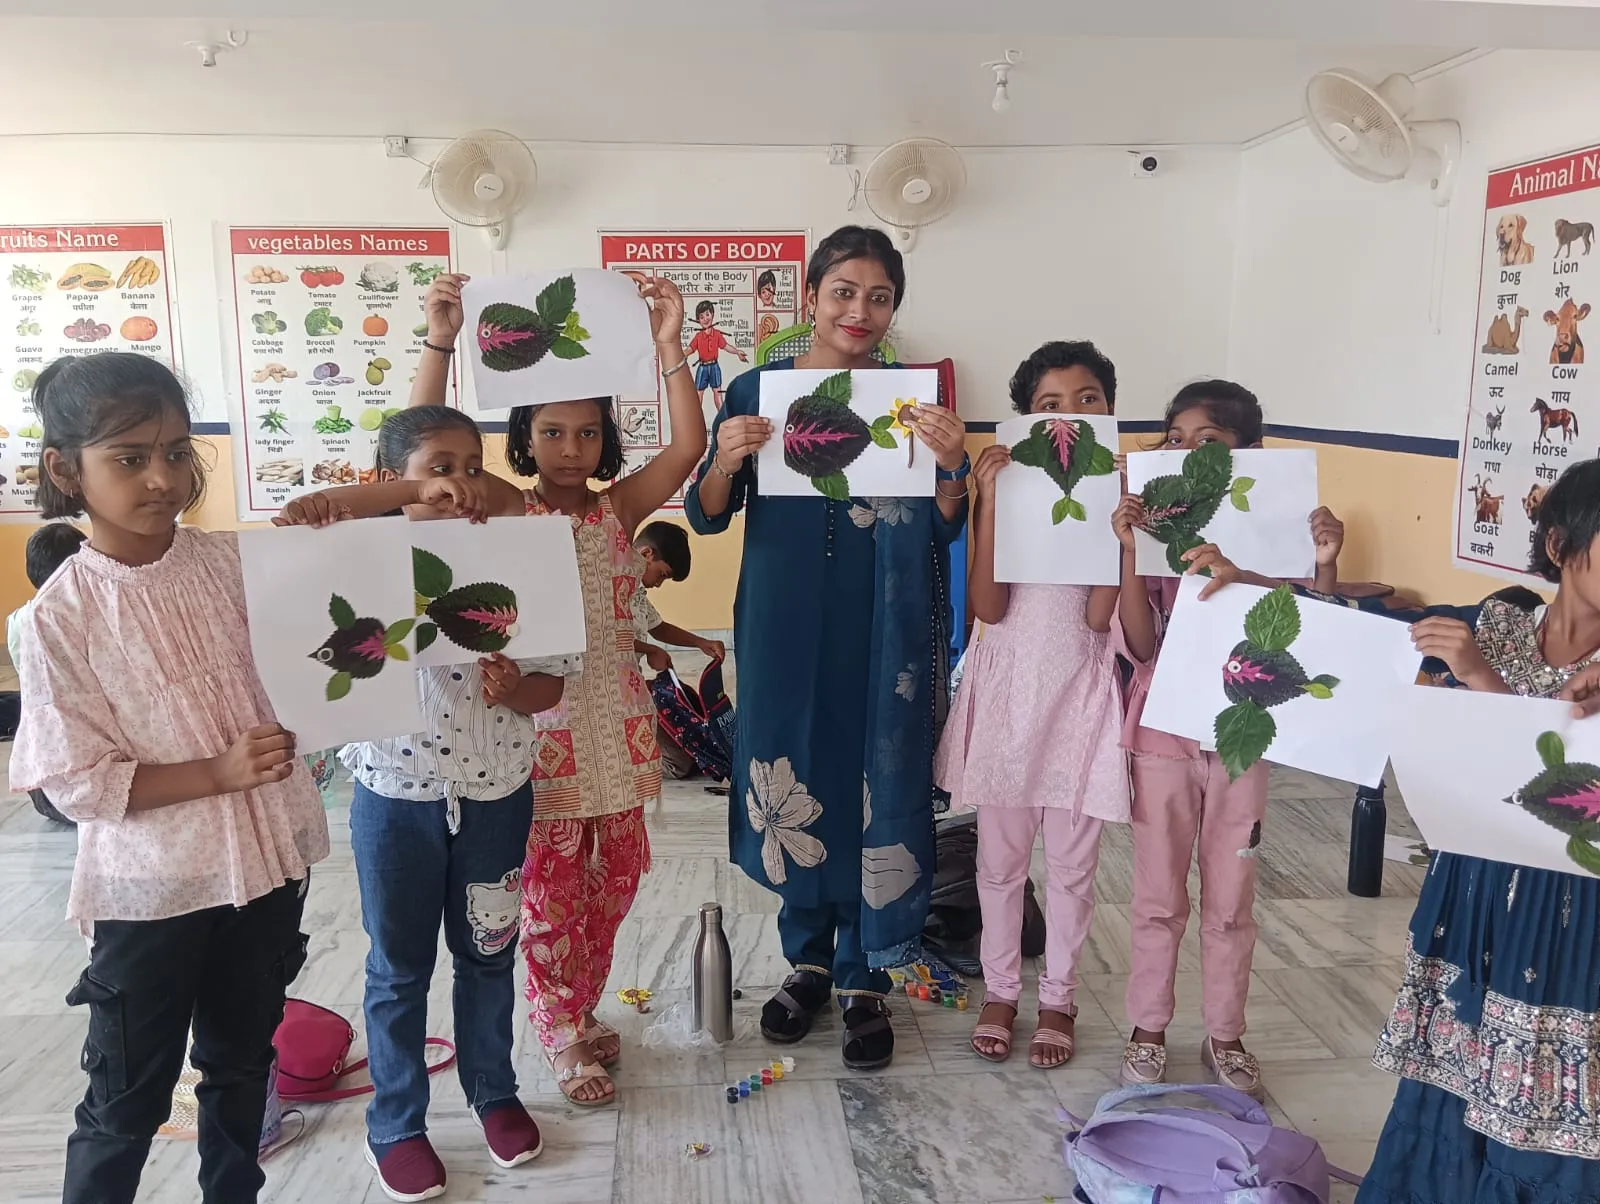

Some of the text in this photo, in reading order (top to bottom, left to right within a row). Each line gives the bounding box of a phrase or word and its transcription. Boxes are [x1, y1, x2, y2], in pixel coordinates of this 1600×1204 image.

[1509, 160, 1575, 198] Animal
[0, 230, 119, 248] ruits Name
[247, 235, 428, 254] vegetables Names
[625, 242, 783, 260] PARTS OF BODY
[1553, 261, 1579, 275] Lion
[664, 271, 748, 282] Parts of the Body
[1500, 271, 1522, 286] Dog
[678, 282, 735, 293] शरीर के अंग
[1555, 282, 1571, 298] शेर
[12, 295, 43, 303] Grapes
[66, 293, 99, 302] Papaya
[121, 292, 156, 300] Banana
[1497, 292, 1518, 310] कुत्ता
[72, 303, 95, 311] पपीता
[130, 302, 148, 310] केला
[59, 347, 119, 355] Pomegranate
[131, 343, 161, 352] Mango
[1484, 362, 1519, 376] Camel
[1551, 366, 1578, 380] Cow
[357, 389, 392, 397] Jackfruit
[1551, 391, 1571, 404] गाय
[1472, 437, 1513, 456] Donkey
[1533, 441, 1568, 458] Horse
[1484, 461, 1502, 474] गधा
[1535, 463, 1558, 483] घोड़ा
[1473, 521, 1500, 537] Goat
[1470, 541, 1495, 557] बकरी
